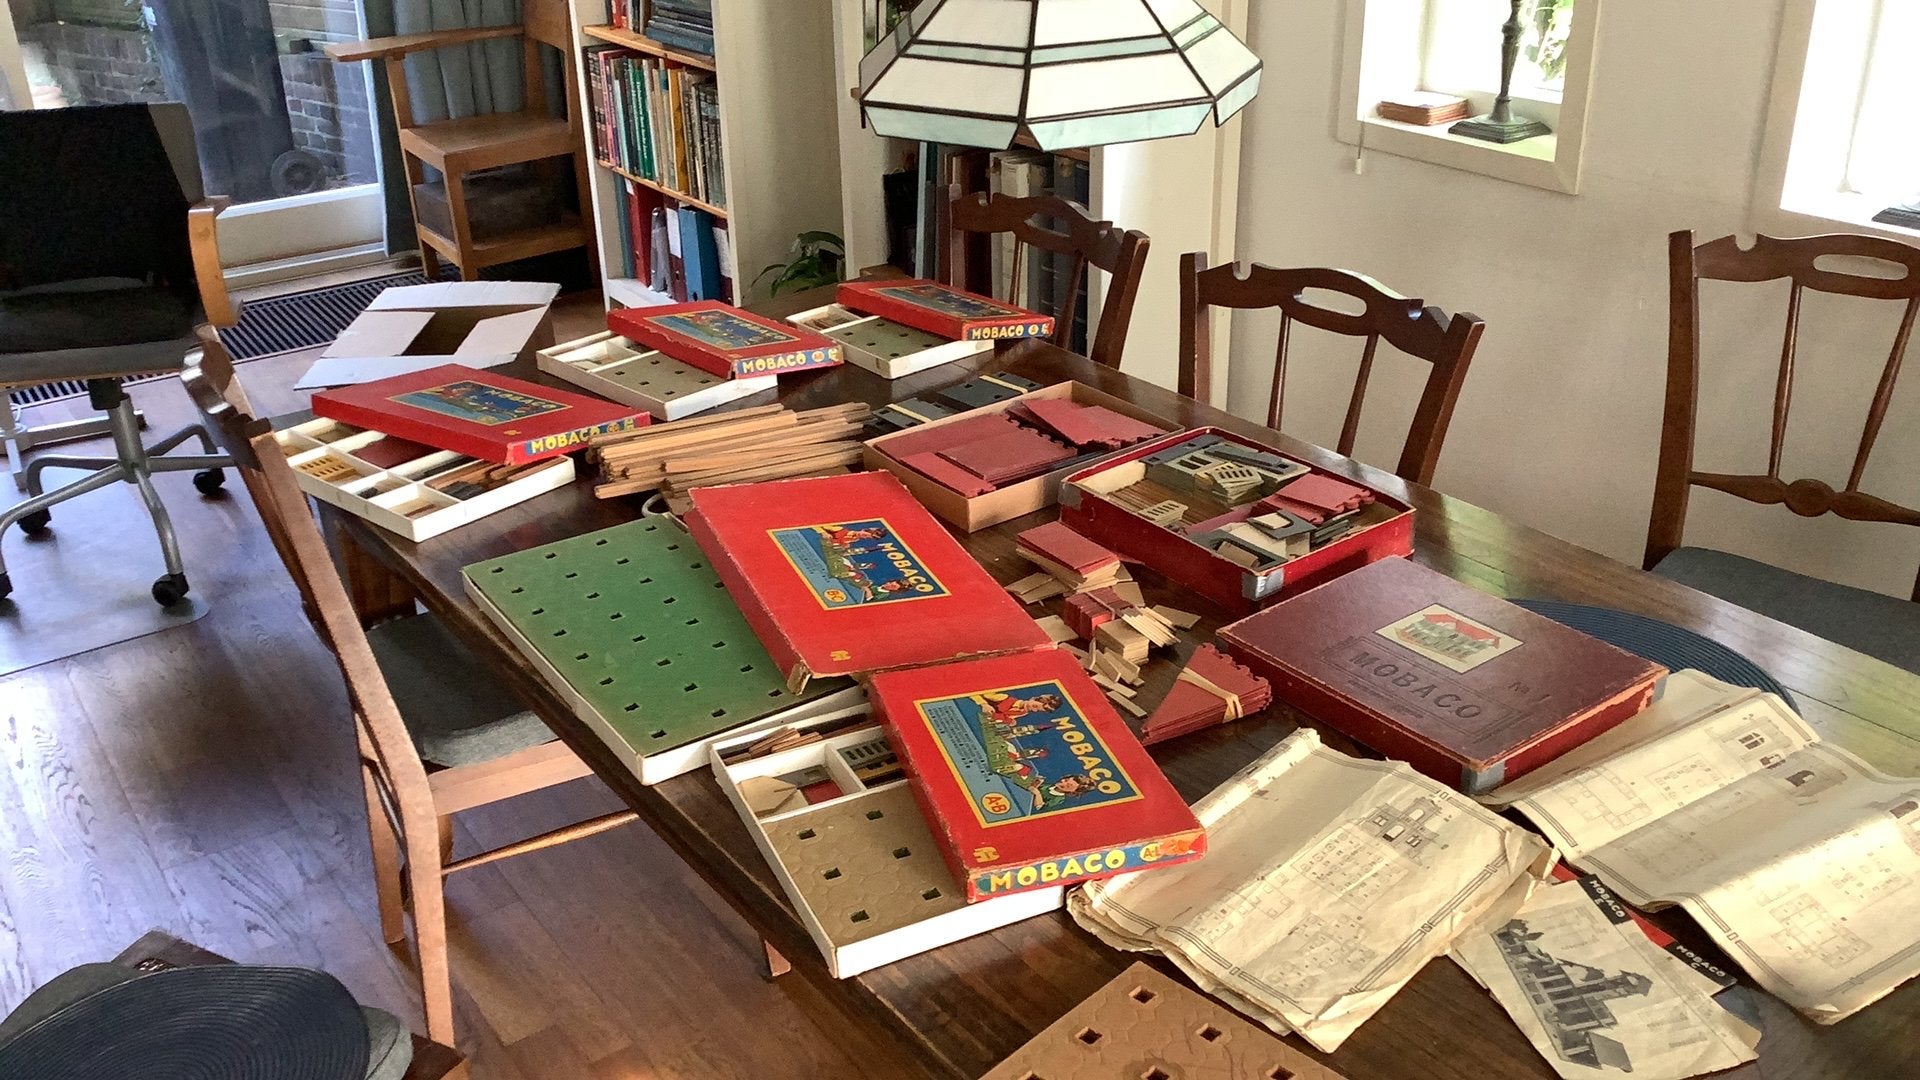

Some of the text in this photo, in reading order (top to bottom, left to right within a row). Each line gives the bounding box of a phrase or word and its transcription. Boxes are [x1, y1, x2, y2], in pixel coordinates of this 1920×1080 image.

[972, 325, 1024, 340] MOBACO
[743, 351, 806, 373] MOBACO
[531, 426, 600, 454] MOBACO
[878, 542, 934, 592] MOBACO
[1349, 651, 1482, 719] MOBACO
[1051, 716, 1122, 794] MOBACO
[990, 849, 1126, 892] MOBACO
[1589, 880, 1625, 918] MOBACO
[1676, 945, 1726, 978] MOBACO
